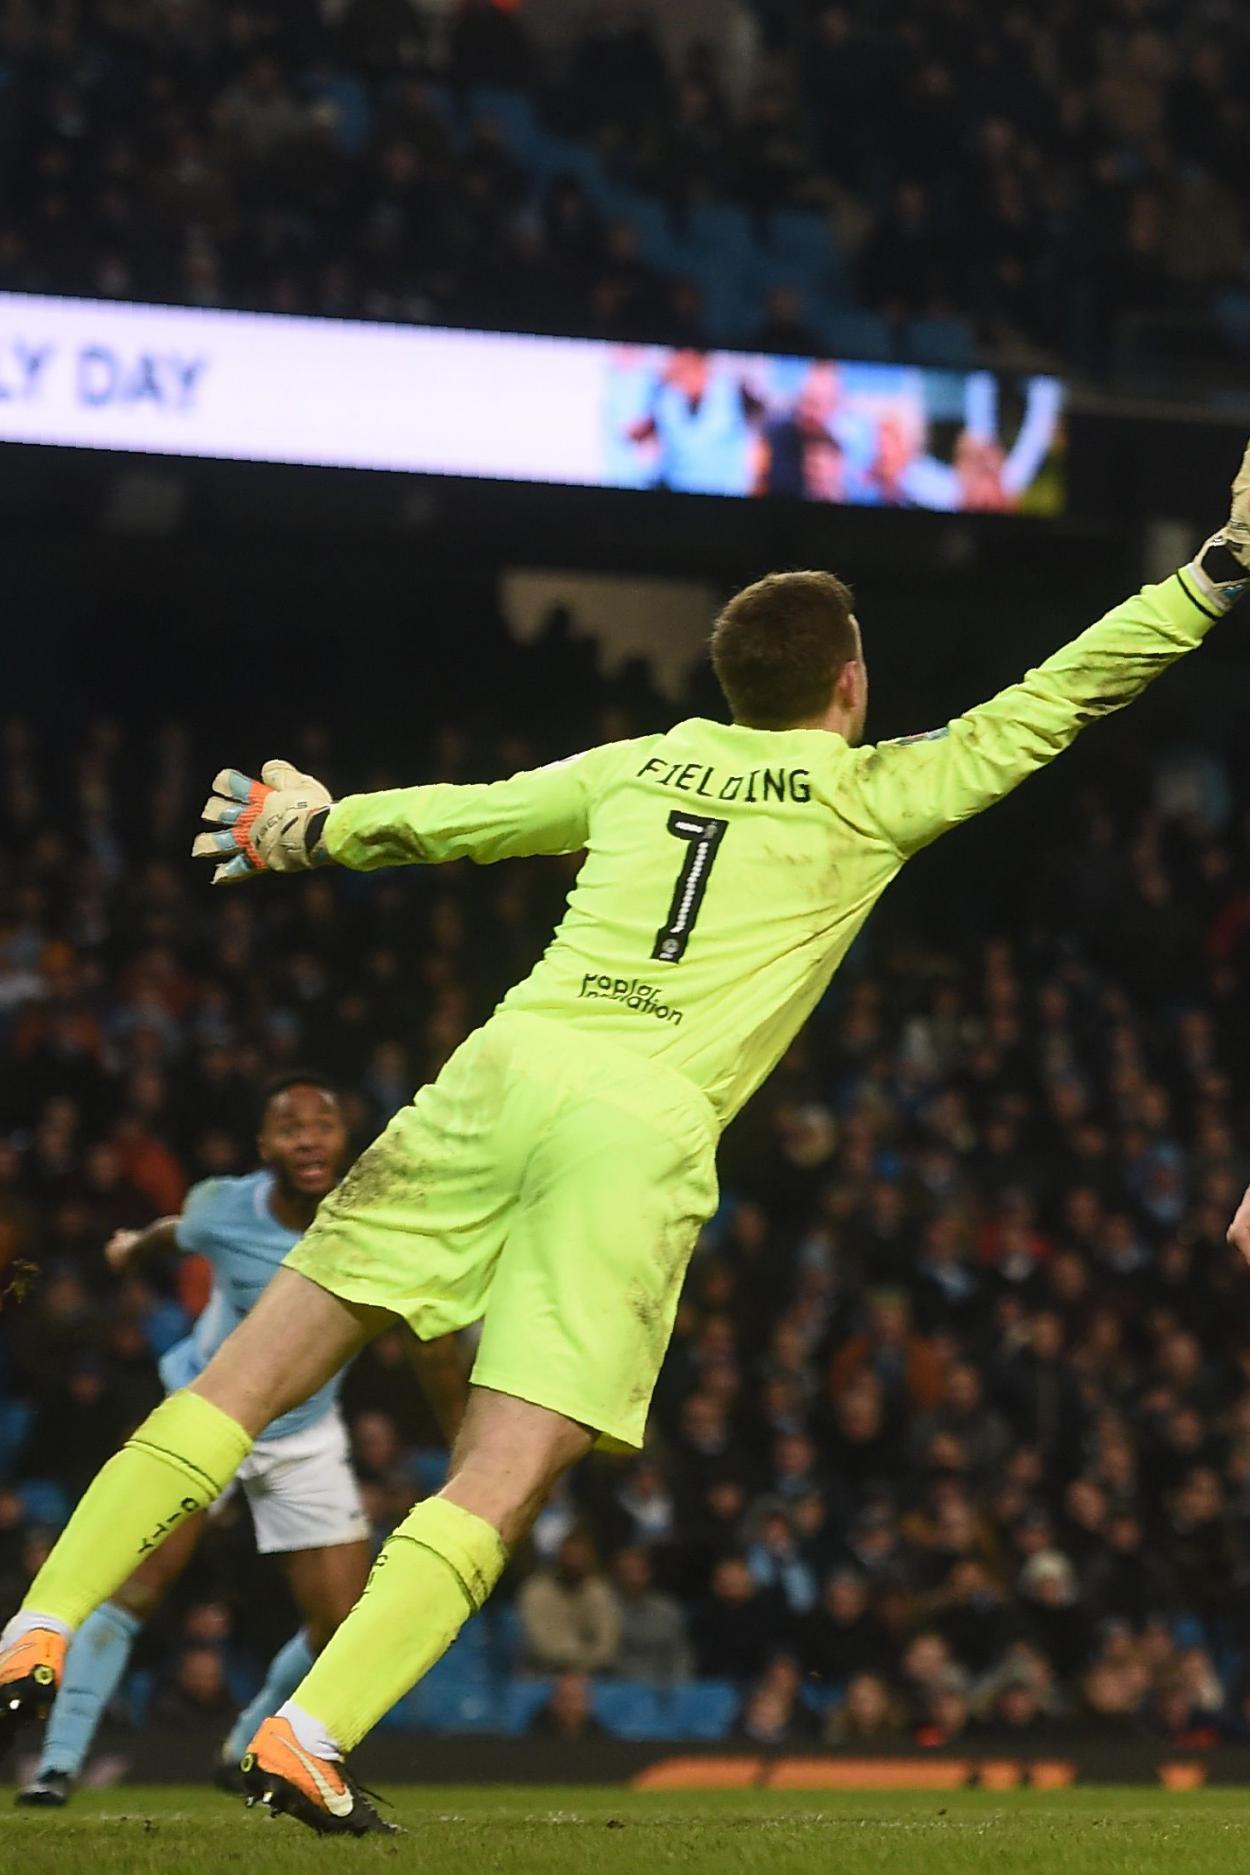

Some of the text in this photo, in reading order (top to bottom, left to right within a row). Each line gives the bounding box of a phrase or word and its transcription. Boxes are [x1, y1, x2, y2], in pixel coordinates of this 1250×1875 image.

[0, 336, 208, 413] Y DAY
[637, 757, 811, 803] FIELDING
[650, 810, 729, 965] 1
